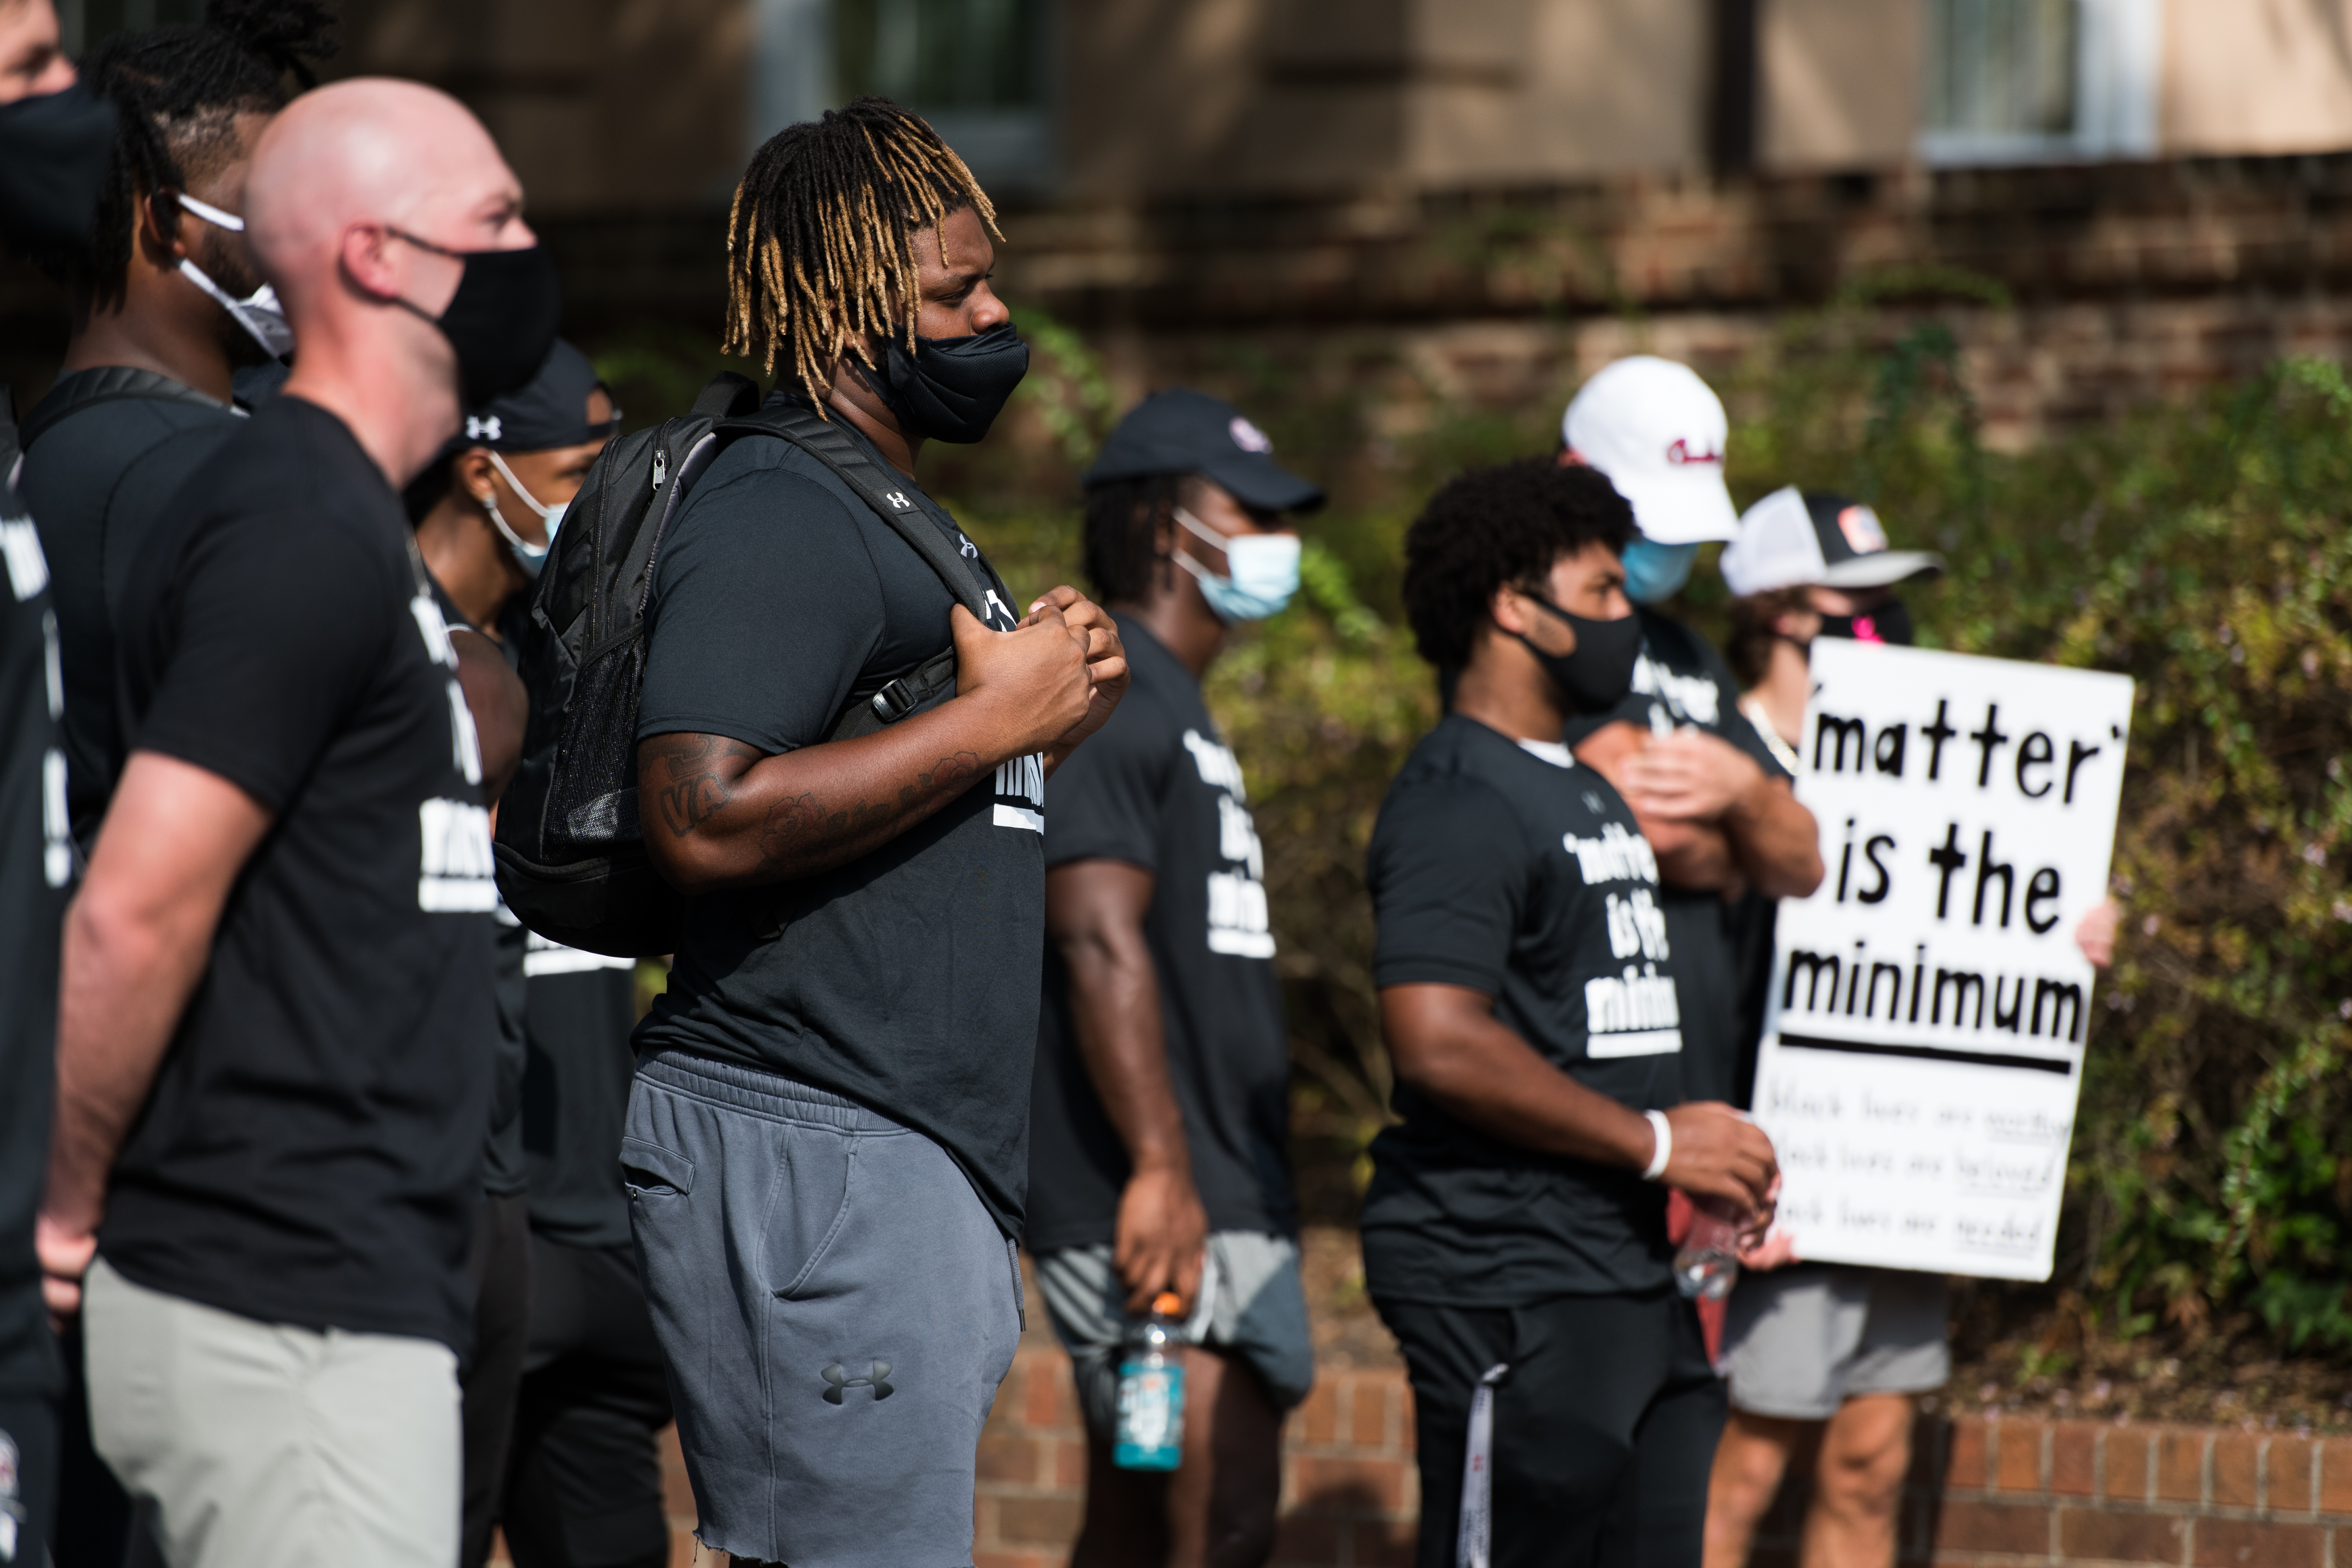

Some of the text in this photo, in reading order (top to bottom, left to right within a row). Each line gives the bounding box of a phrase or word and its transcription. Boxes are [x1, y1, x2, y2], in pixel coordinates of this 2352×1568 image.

[1837, 819, 2060, 933] is the
[1784, 940, 2082, 1042] minimum
